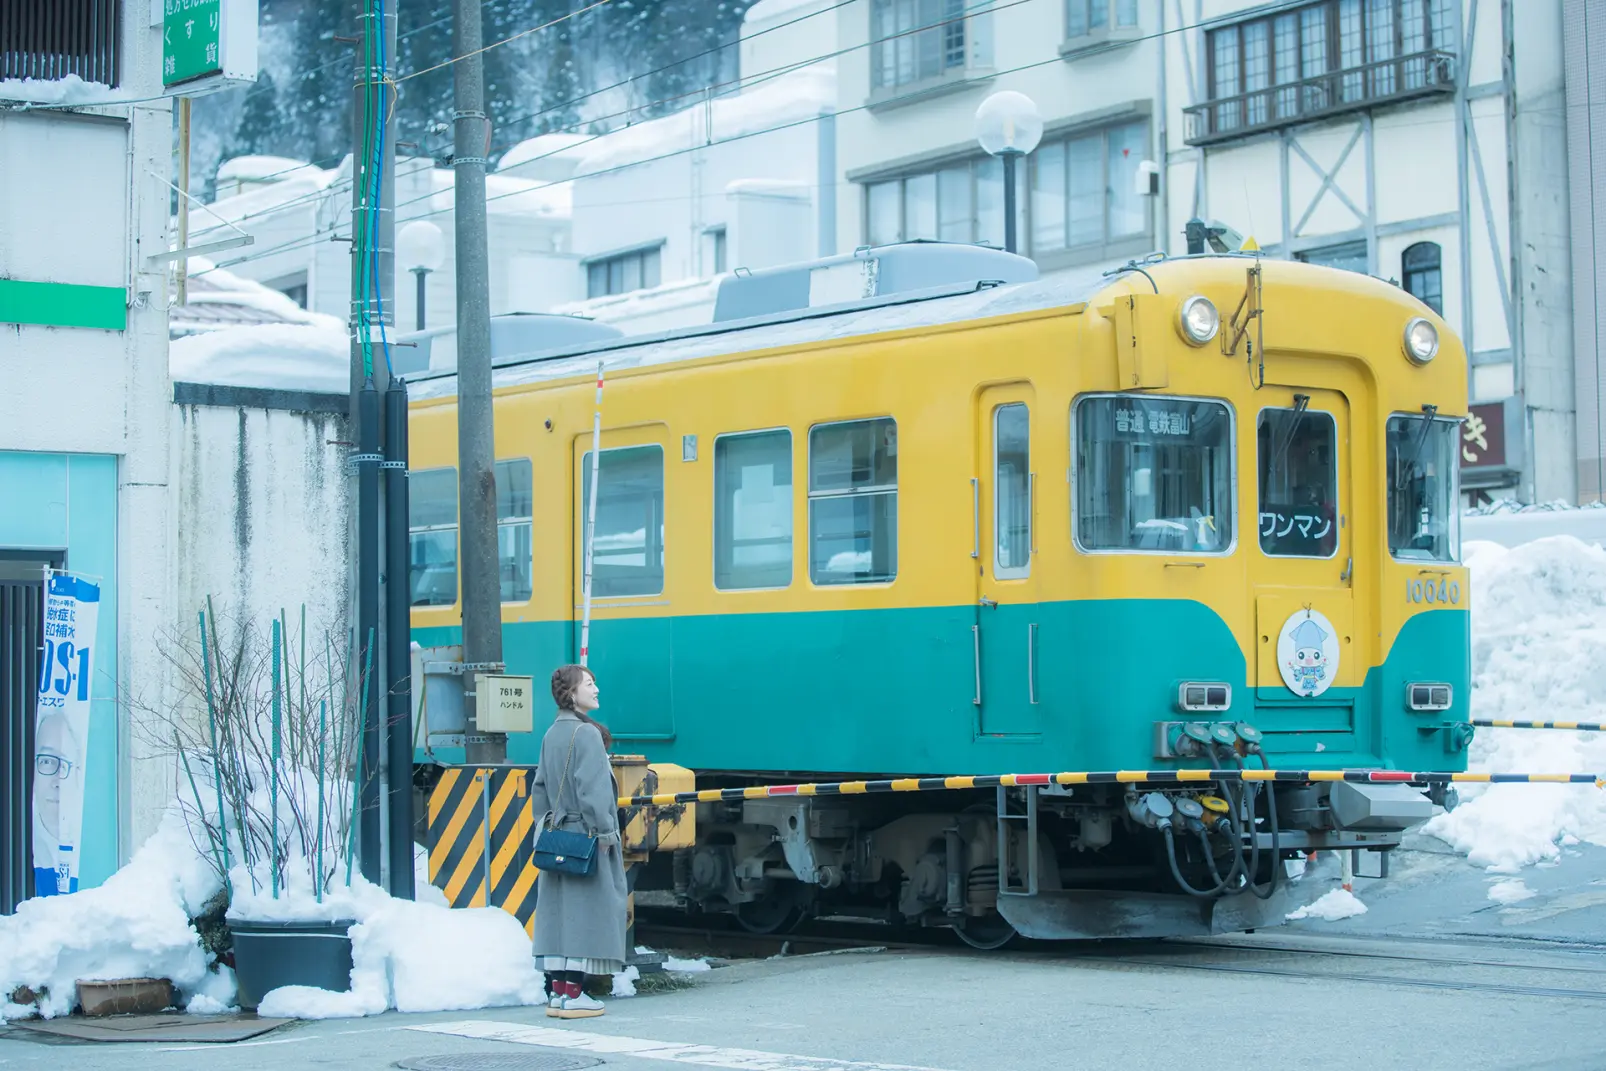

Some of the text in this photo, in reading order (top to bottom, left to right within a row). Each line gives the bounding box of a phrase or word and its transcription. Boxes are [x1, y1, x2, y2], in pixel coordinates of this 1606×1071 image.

[165, 12, 218, 45] くすり
[1116, 408, 1190, 435] 普通 電鉄富山
[1259, 512, 1331, 539] ワンマン
[1406, 578, 1461, 604] 10040
[499, 687, 523, 697] 761号
[500, 701, 524, 709] ハンドル
